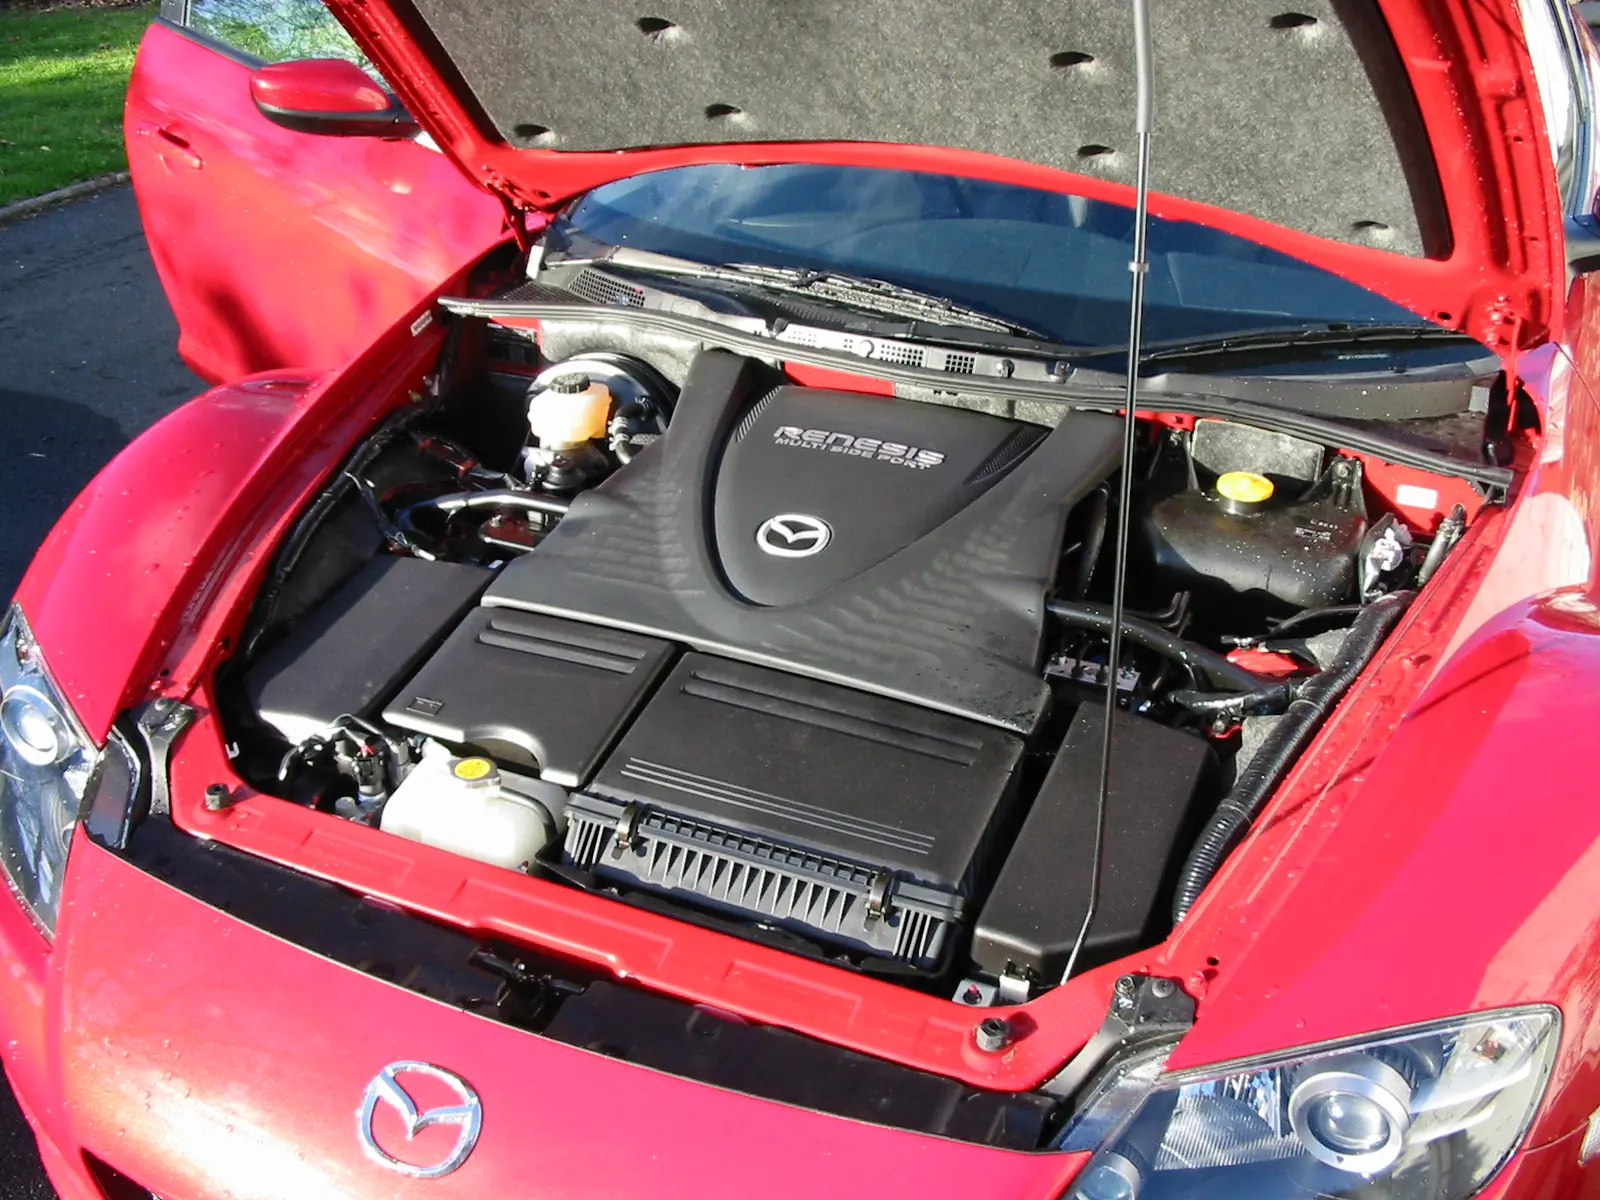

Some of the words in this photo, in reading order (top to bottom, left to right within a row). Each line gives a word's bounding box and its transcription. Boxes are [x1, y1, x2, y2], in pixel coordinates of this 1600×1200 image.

[773, 426, 945, 465] RENESIS
[774, 438, 827, 450] MULTI
[829, 445, 873, 458] SIDE
[877, 454, 931, 470] PORT
